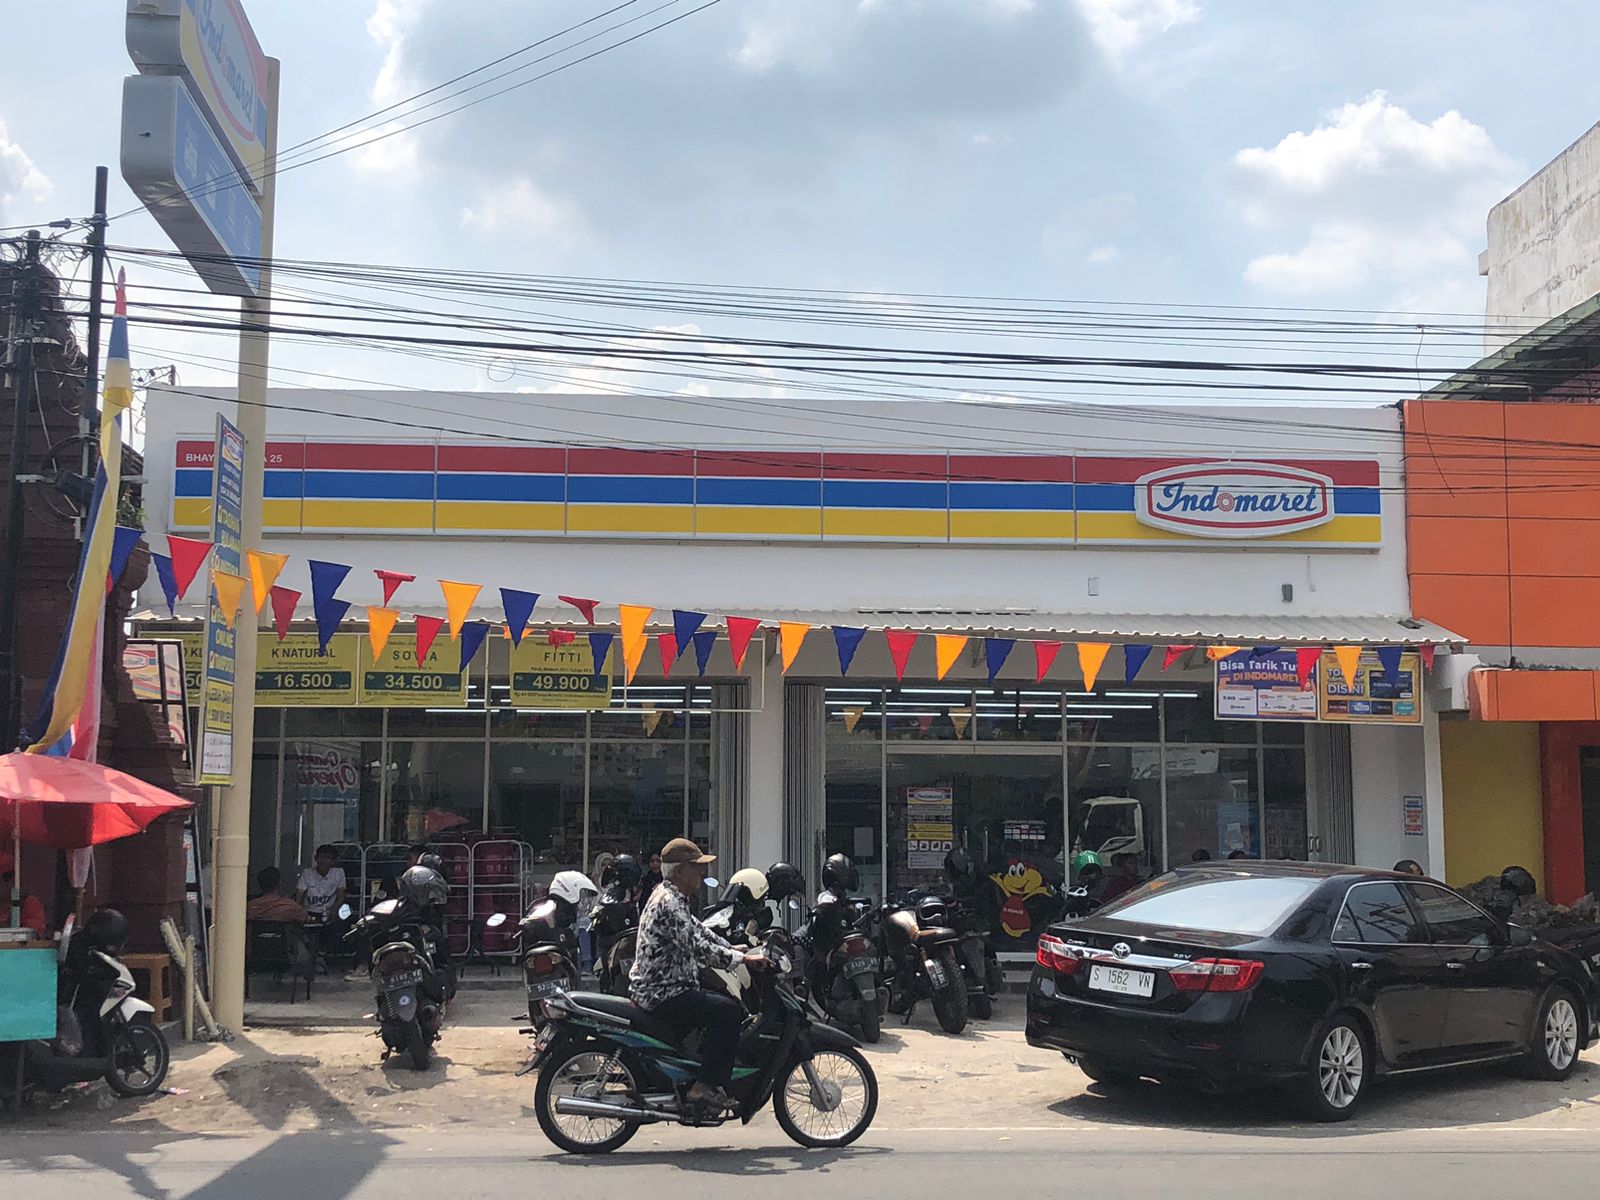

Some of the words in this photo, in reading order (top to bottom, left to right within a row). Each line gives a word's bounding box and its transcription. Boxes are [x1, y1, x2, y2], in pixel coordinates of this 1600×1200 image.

[270, 454, 282, 463] 25
[1156, 481, 1317, 512] Indomaret
[271, 648, 279, 658] K
[282, 648, 336, 658] NATURAL
[544, 652, 581, 662] FITTI
[1219, 660, 1245, 671] Bisa
[1249, 660, 1278, 670] Tarik
[274, 673, 332, 688] 16.500
[384, 674, 443, 689] 34.500
[532, 675, 590, 690] 49.900
[1233, 673, 1243, 681] DI
[1245, 672, 1299, 684] INDOMARET
[1094, 968, 1101, 981] S
[1108, 970, 1129, 985] 1562
[1138, 973, 1151, 988] VN
